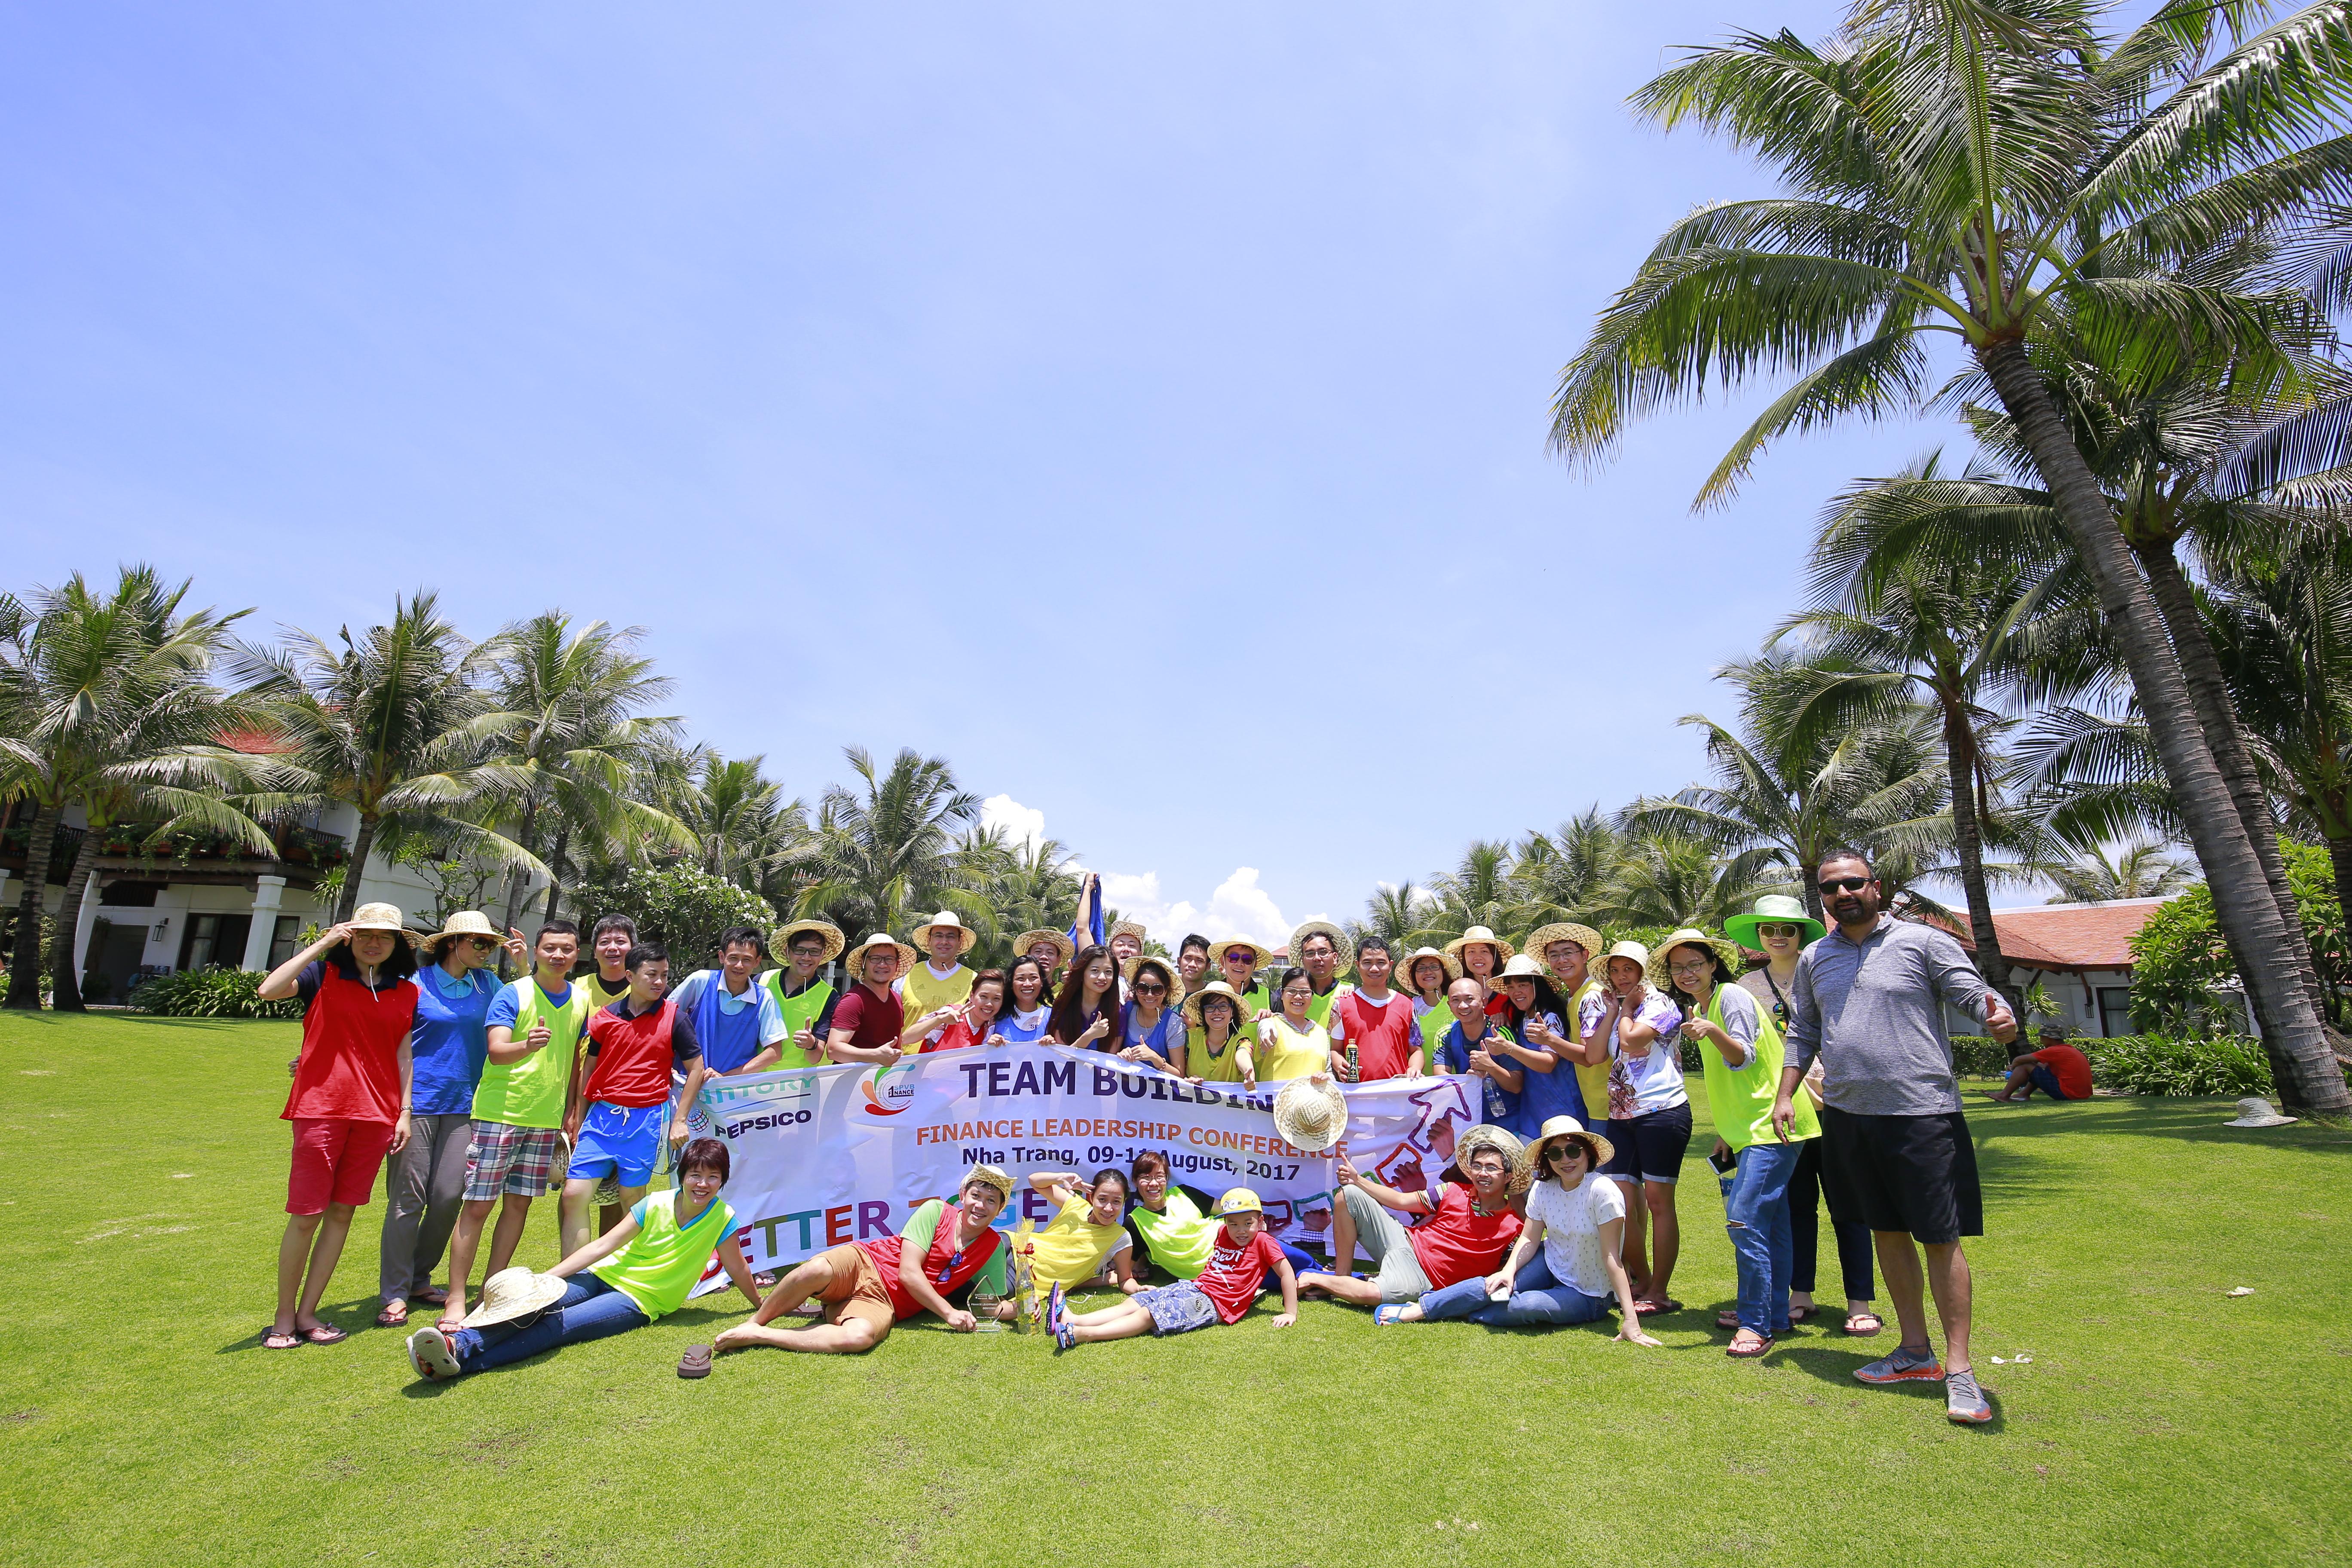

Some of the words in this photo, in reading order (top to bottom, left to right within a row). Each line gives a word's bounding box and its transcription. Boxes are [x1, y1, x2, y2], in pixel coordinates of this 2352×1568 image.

[933, 995, 947, 1004] Fly
[679, 1075, 817, 1105] UNTORY
[960, 1061, 1076, 1097] TEAM
[1093, 1065, 1274, 1113] BUILDIN
[715, 1110, 812, 1139] PEPSICO
[917, 1120, 1023, 1145] FINANCE
[1032, 1119, 1182, 1140] LEADERSHIP
[963, 1147, 1005, 1165] Nha
[1012, 1146, 1080, 1166] Trang,
[1161, 1149, 1238, 1176] August,
[1246, 1160, 1300, 1181] 2017
[738, 1200, 894, 1264] ETTER
